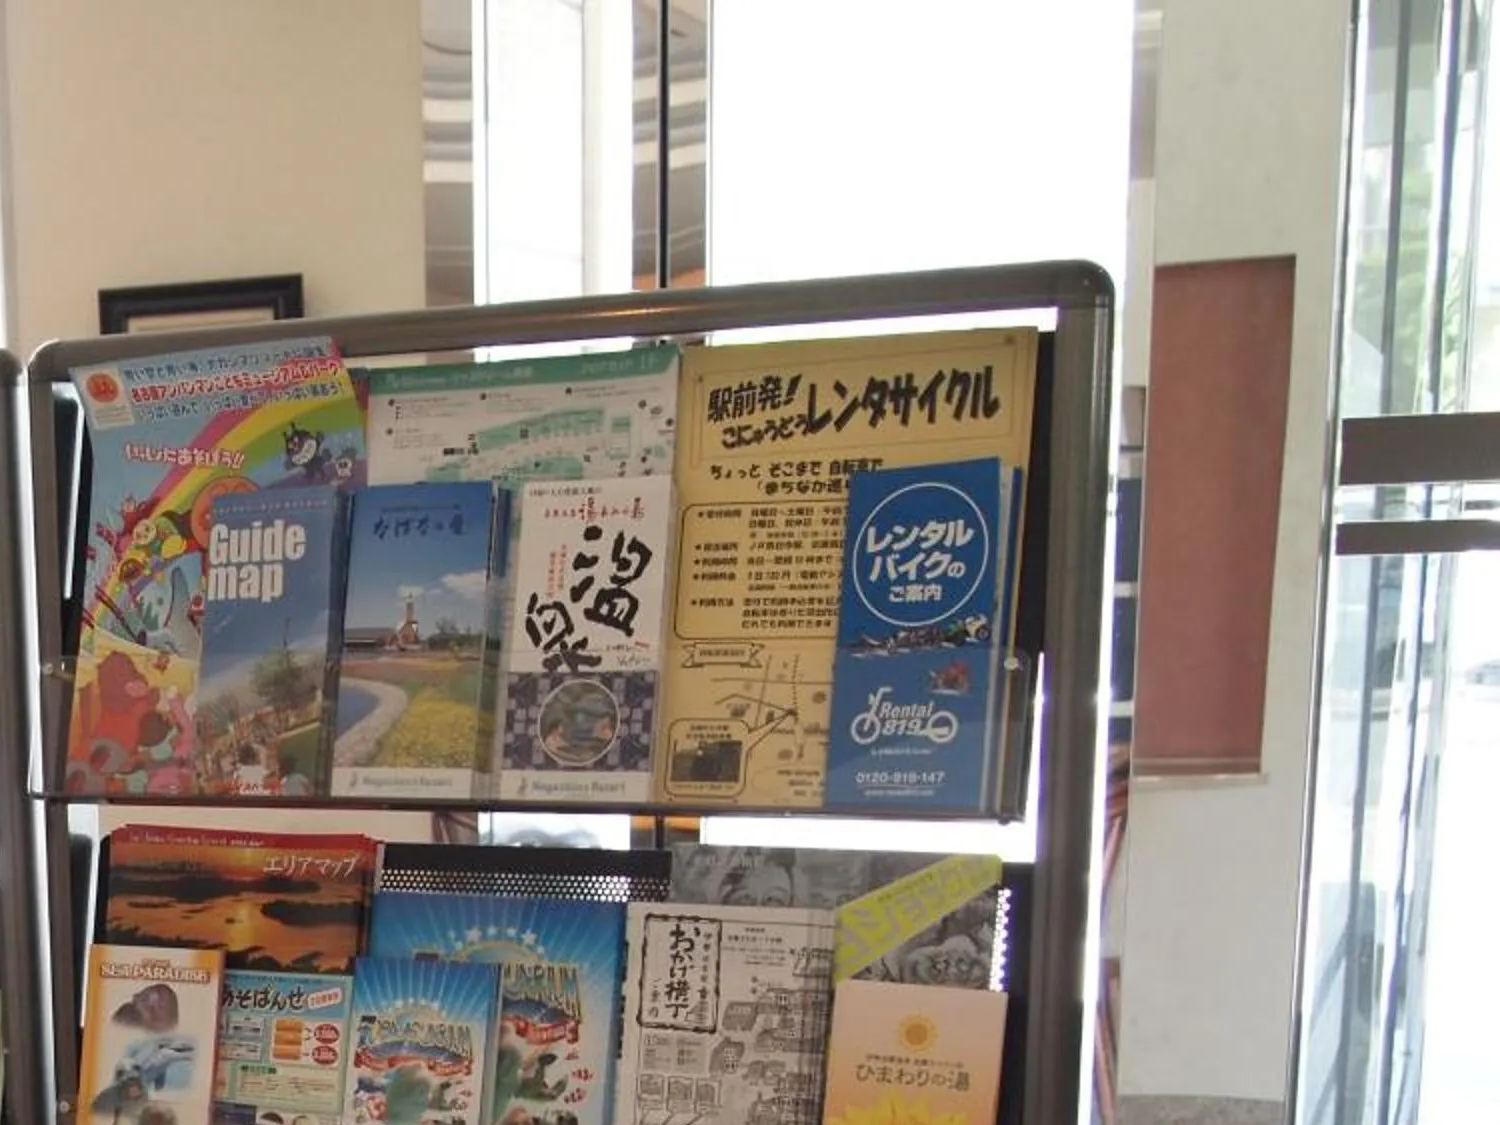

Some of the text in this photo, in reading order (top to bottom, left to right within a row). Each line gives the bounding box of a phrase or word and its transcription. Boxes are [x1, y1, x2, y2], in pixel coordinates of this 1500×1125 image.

[807, 364, 1002, 435] レンタサイクル
[710, 463, 761, 481] ちょっと
[768, 460, 823, 477] そこまで
[209, 518, 308, 566] Guide
[864, 518, 974, 554] レンタル
[206, 561, 285, 603] map
[868, 551, 967, 583] バイクの
[887, 582, 944, 604] ご案内
[878, 700, 935, 720] Rental
[881, 719, 922, 736] 819
[262, 853, 362, 878] エリアマップ
[664, 922, 701, 1020] おかげ横丁
[855, 1062, 971, 1092] ひまわりの湯
